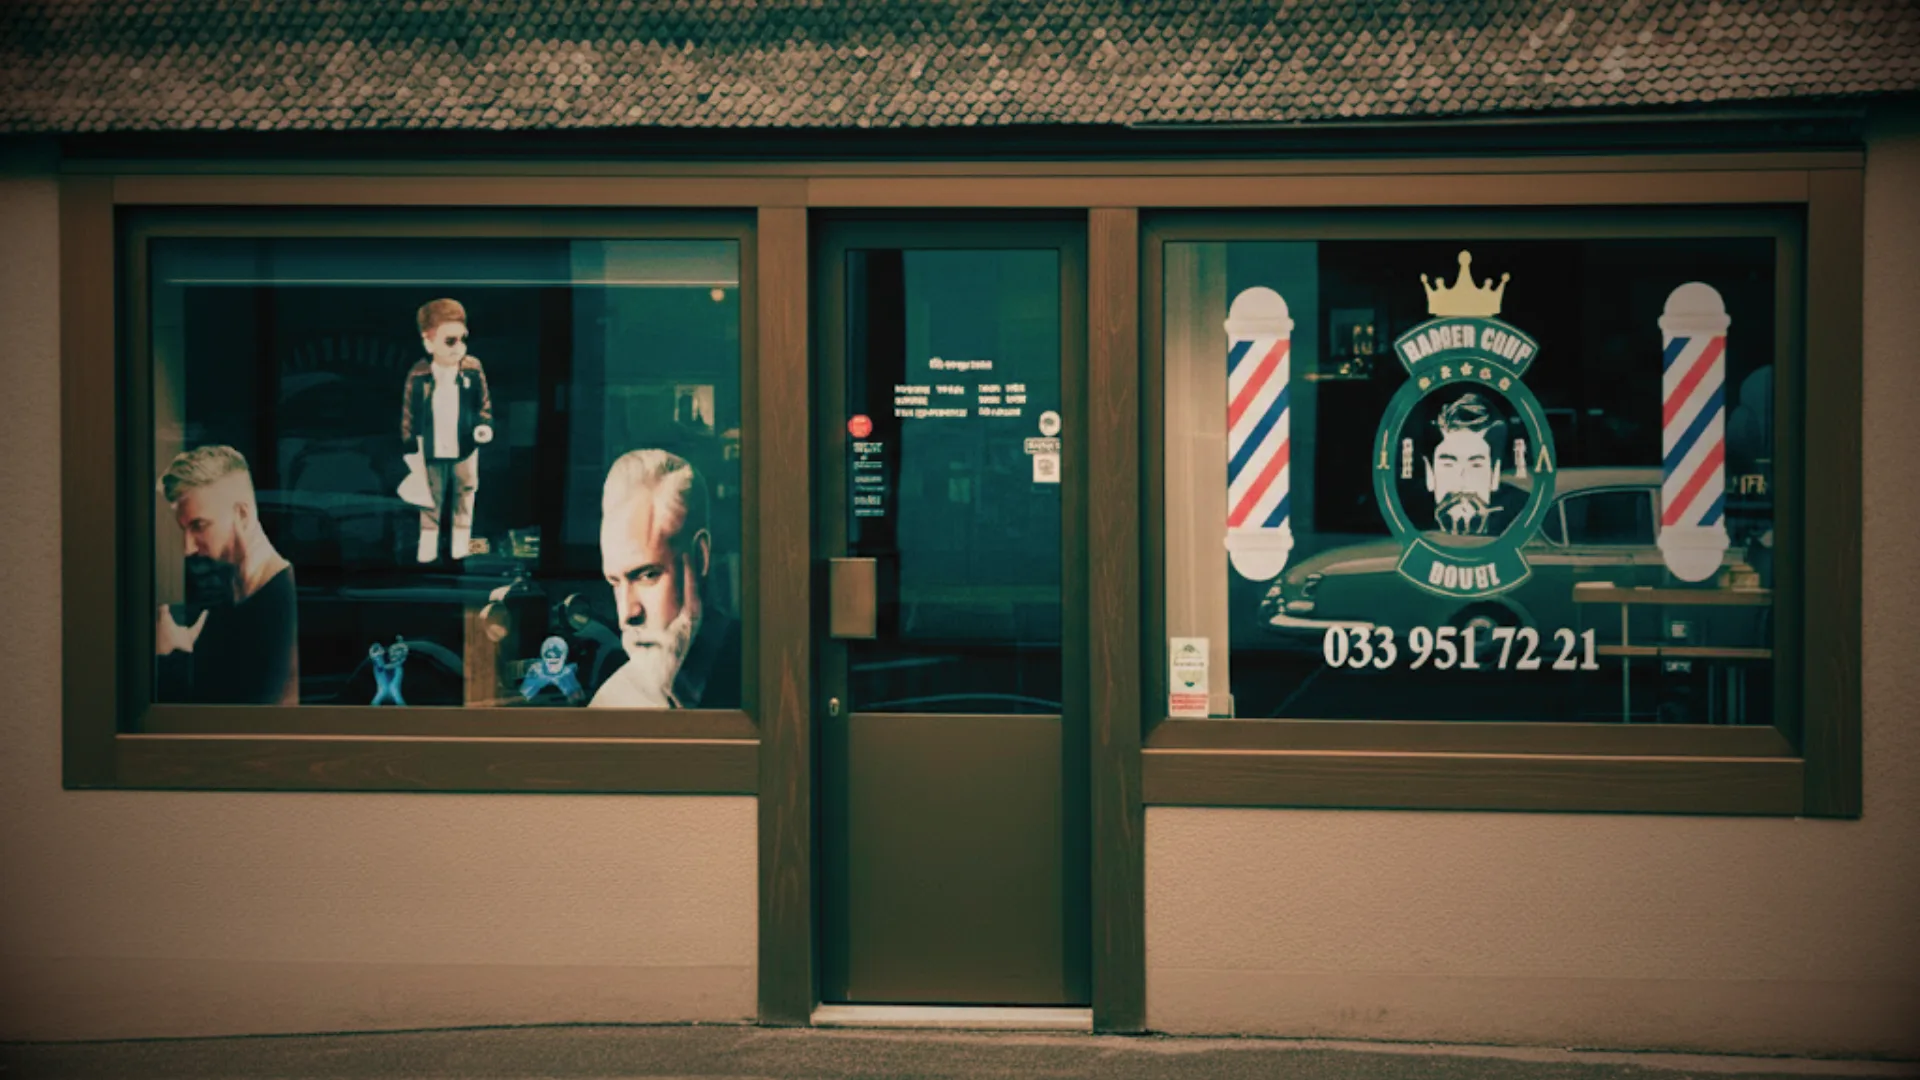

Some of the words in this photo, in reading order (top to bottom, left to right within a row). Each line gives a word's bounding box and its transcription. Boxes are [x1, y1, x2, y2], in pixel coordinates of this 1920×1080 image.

[1323, 626, 1398, 669] 033
[1408, 626, 1480, 670] 951
[1492, 627, 1541, 670] 72
[1552, 628, 1600, 670] 21
